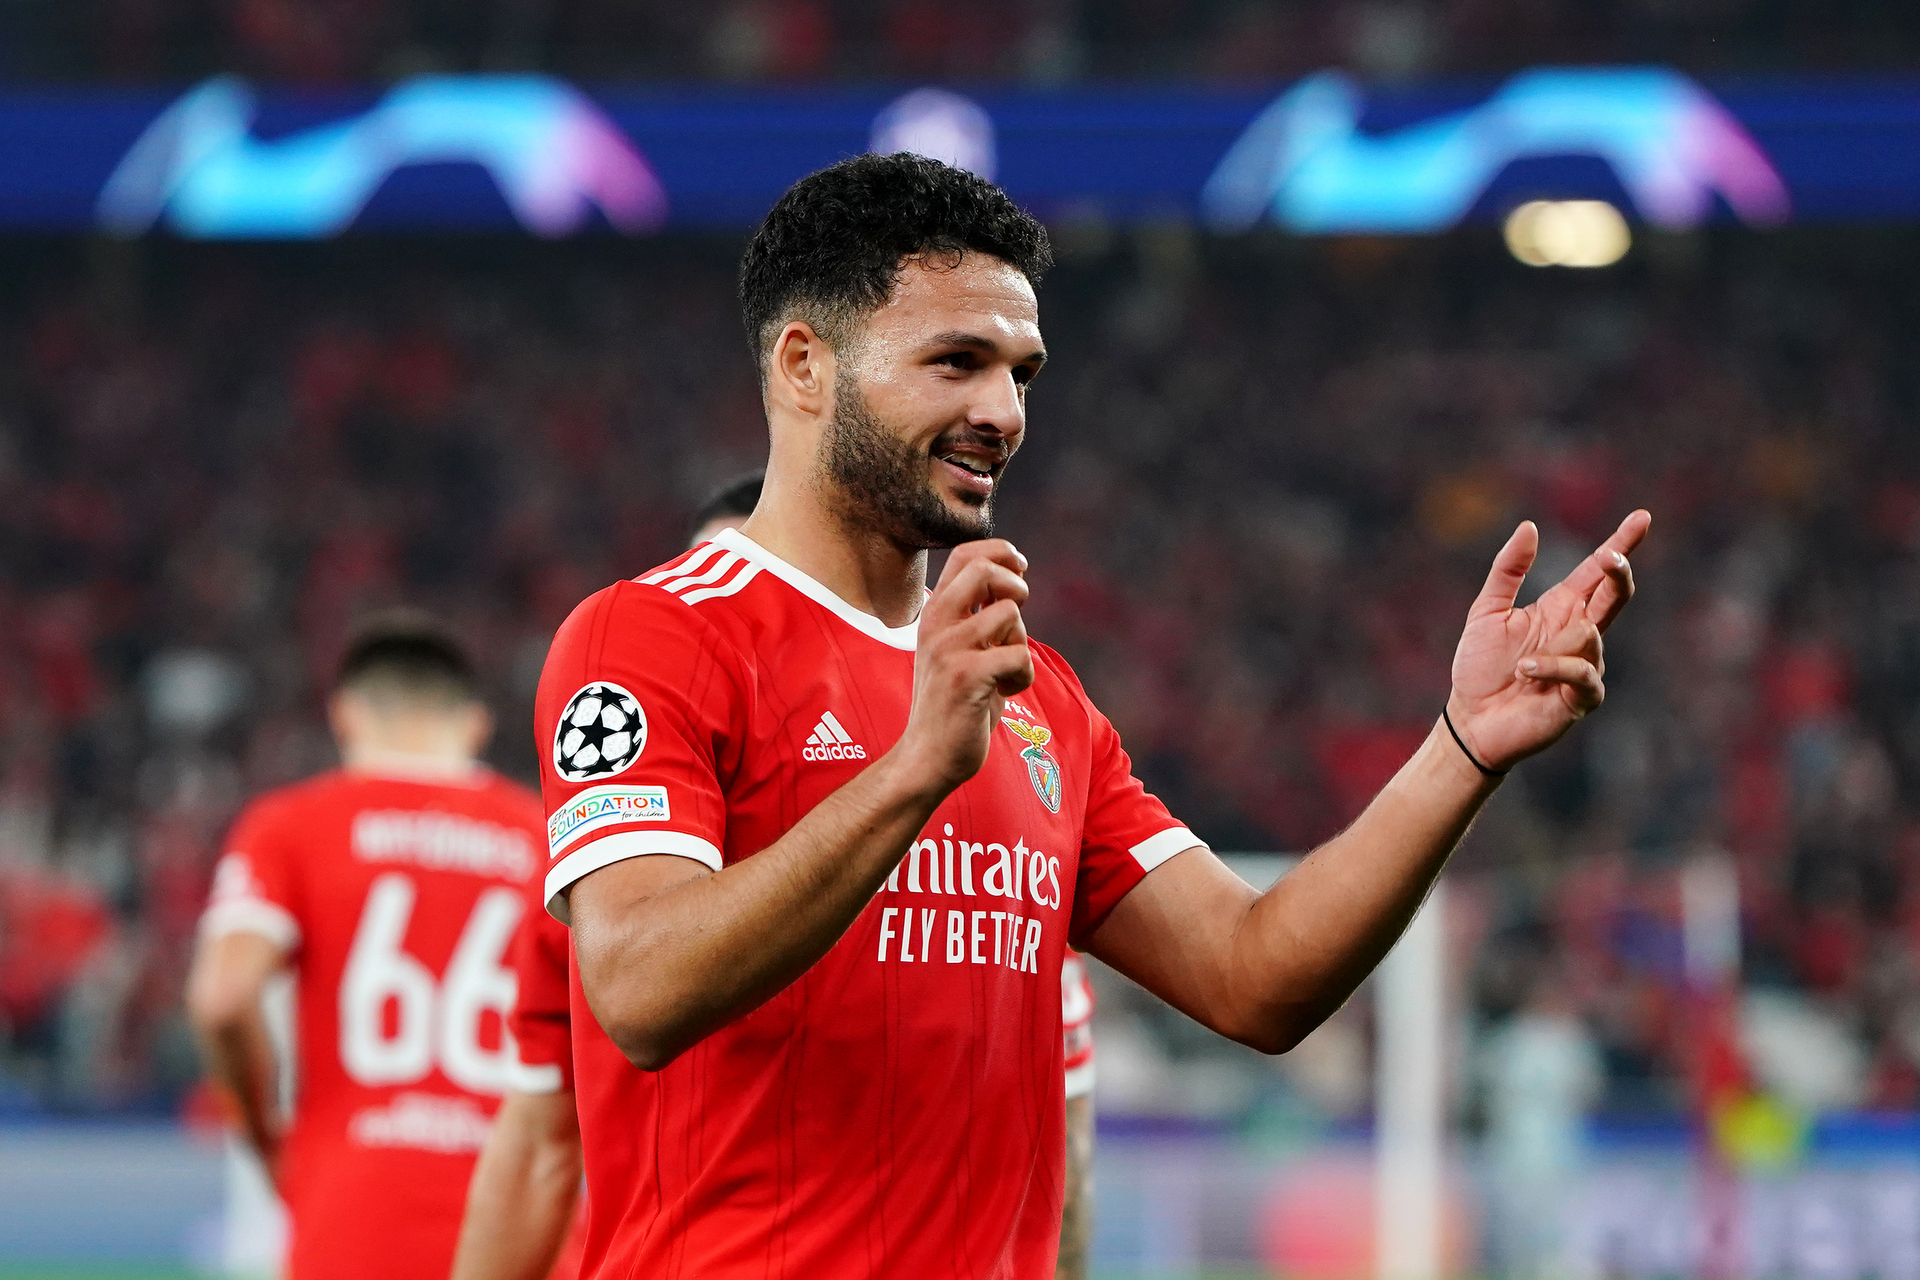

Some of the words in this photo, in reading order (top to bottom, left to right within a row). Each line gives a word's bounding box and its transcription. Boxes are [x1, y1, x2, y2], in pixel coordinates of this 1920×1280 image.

[802, 742, 867, 762] adidas
[550, 809, 567, 828] UEFA
[621, 811, 632, 821] for
[876, 823, 1061, 911] mirates
[877, 907, 937, 963] FLY
[946, 909, 1042, 974] BETTER
[338, 871, 523, 1095] 66
